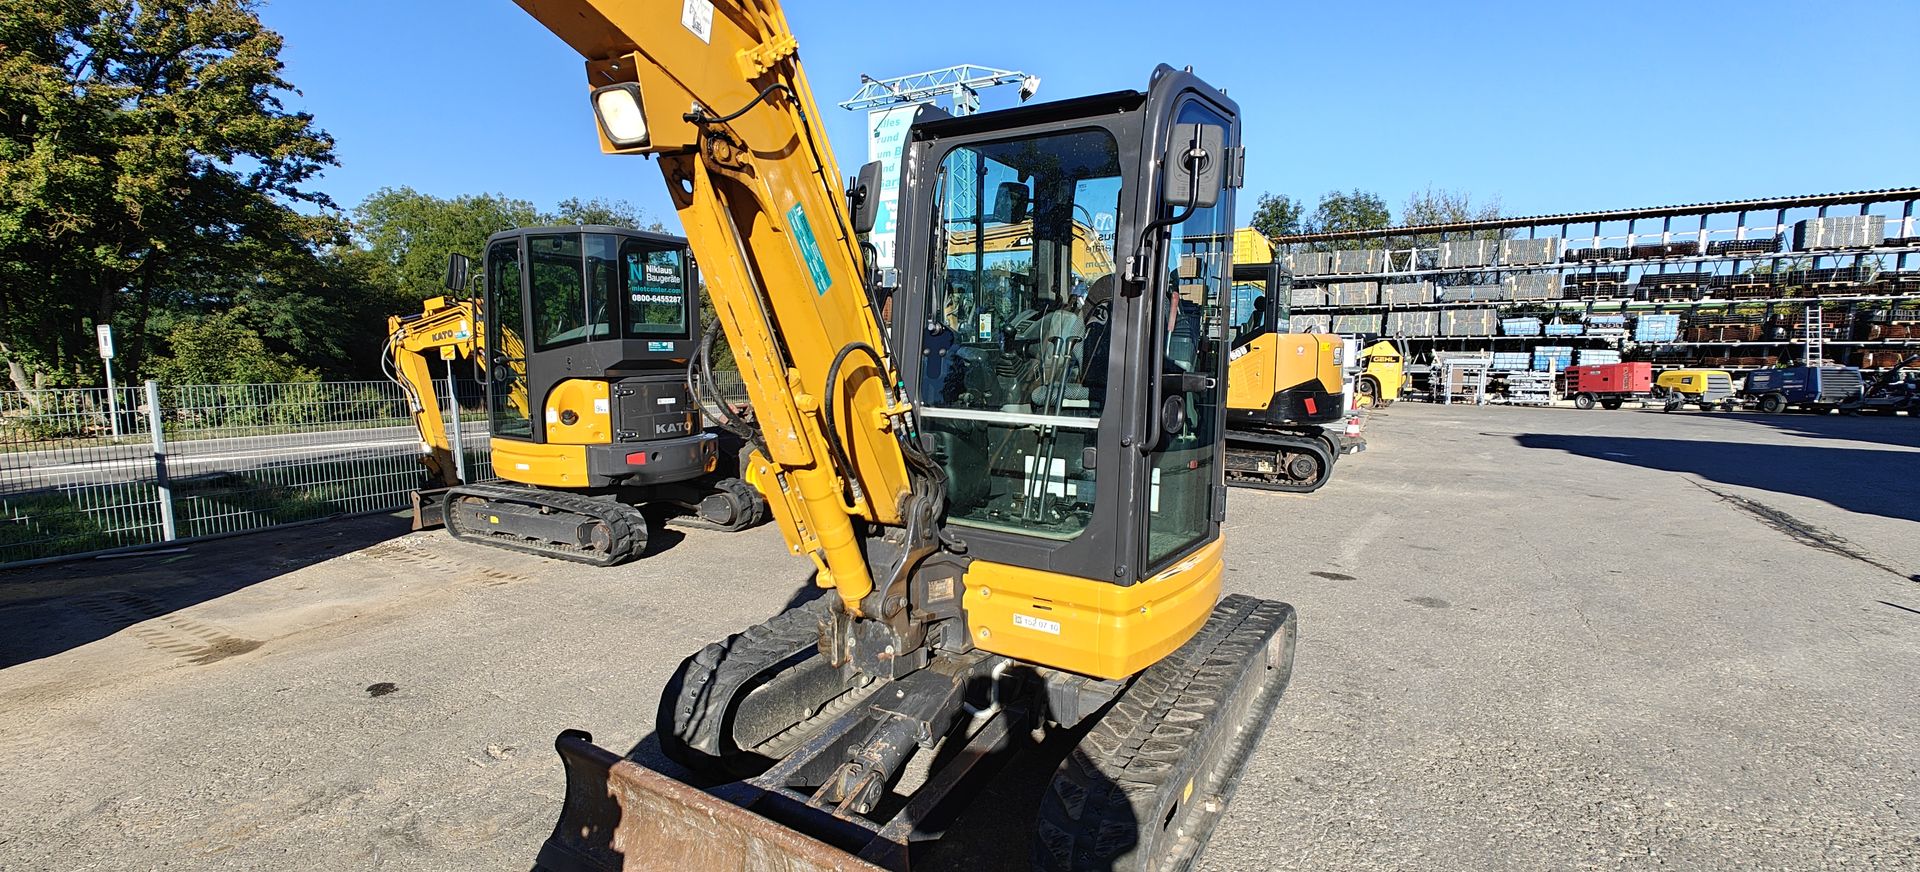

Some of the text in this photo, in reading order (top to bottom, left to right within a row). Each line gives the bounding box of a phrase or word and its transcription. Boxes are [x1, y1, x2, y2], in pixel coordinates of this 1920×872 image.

[630, 262, 643, 281] N
[646, 264, 673, 275] Niklaus
[646, 273, 680, 284] Baugeräte
[631, 294, 682, 303] 0800-6455287
[432, 330, 453, 342] KATO
[656, 422, 692, 434] KATO
